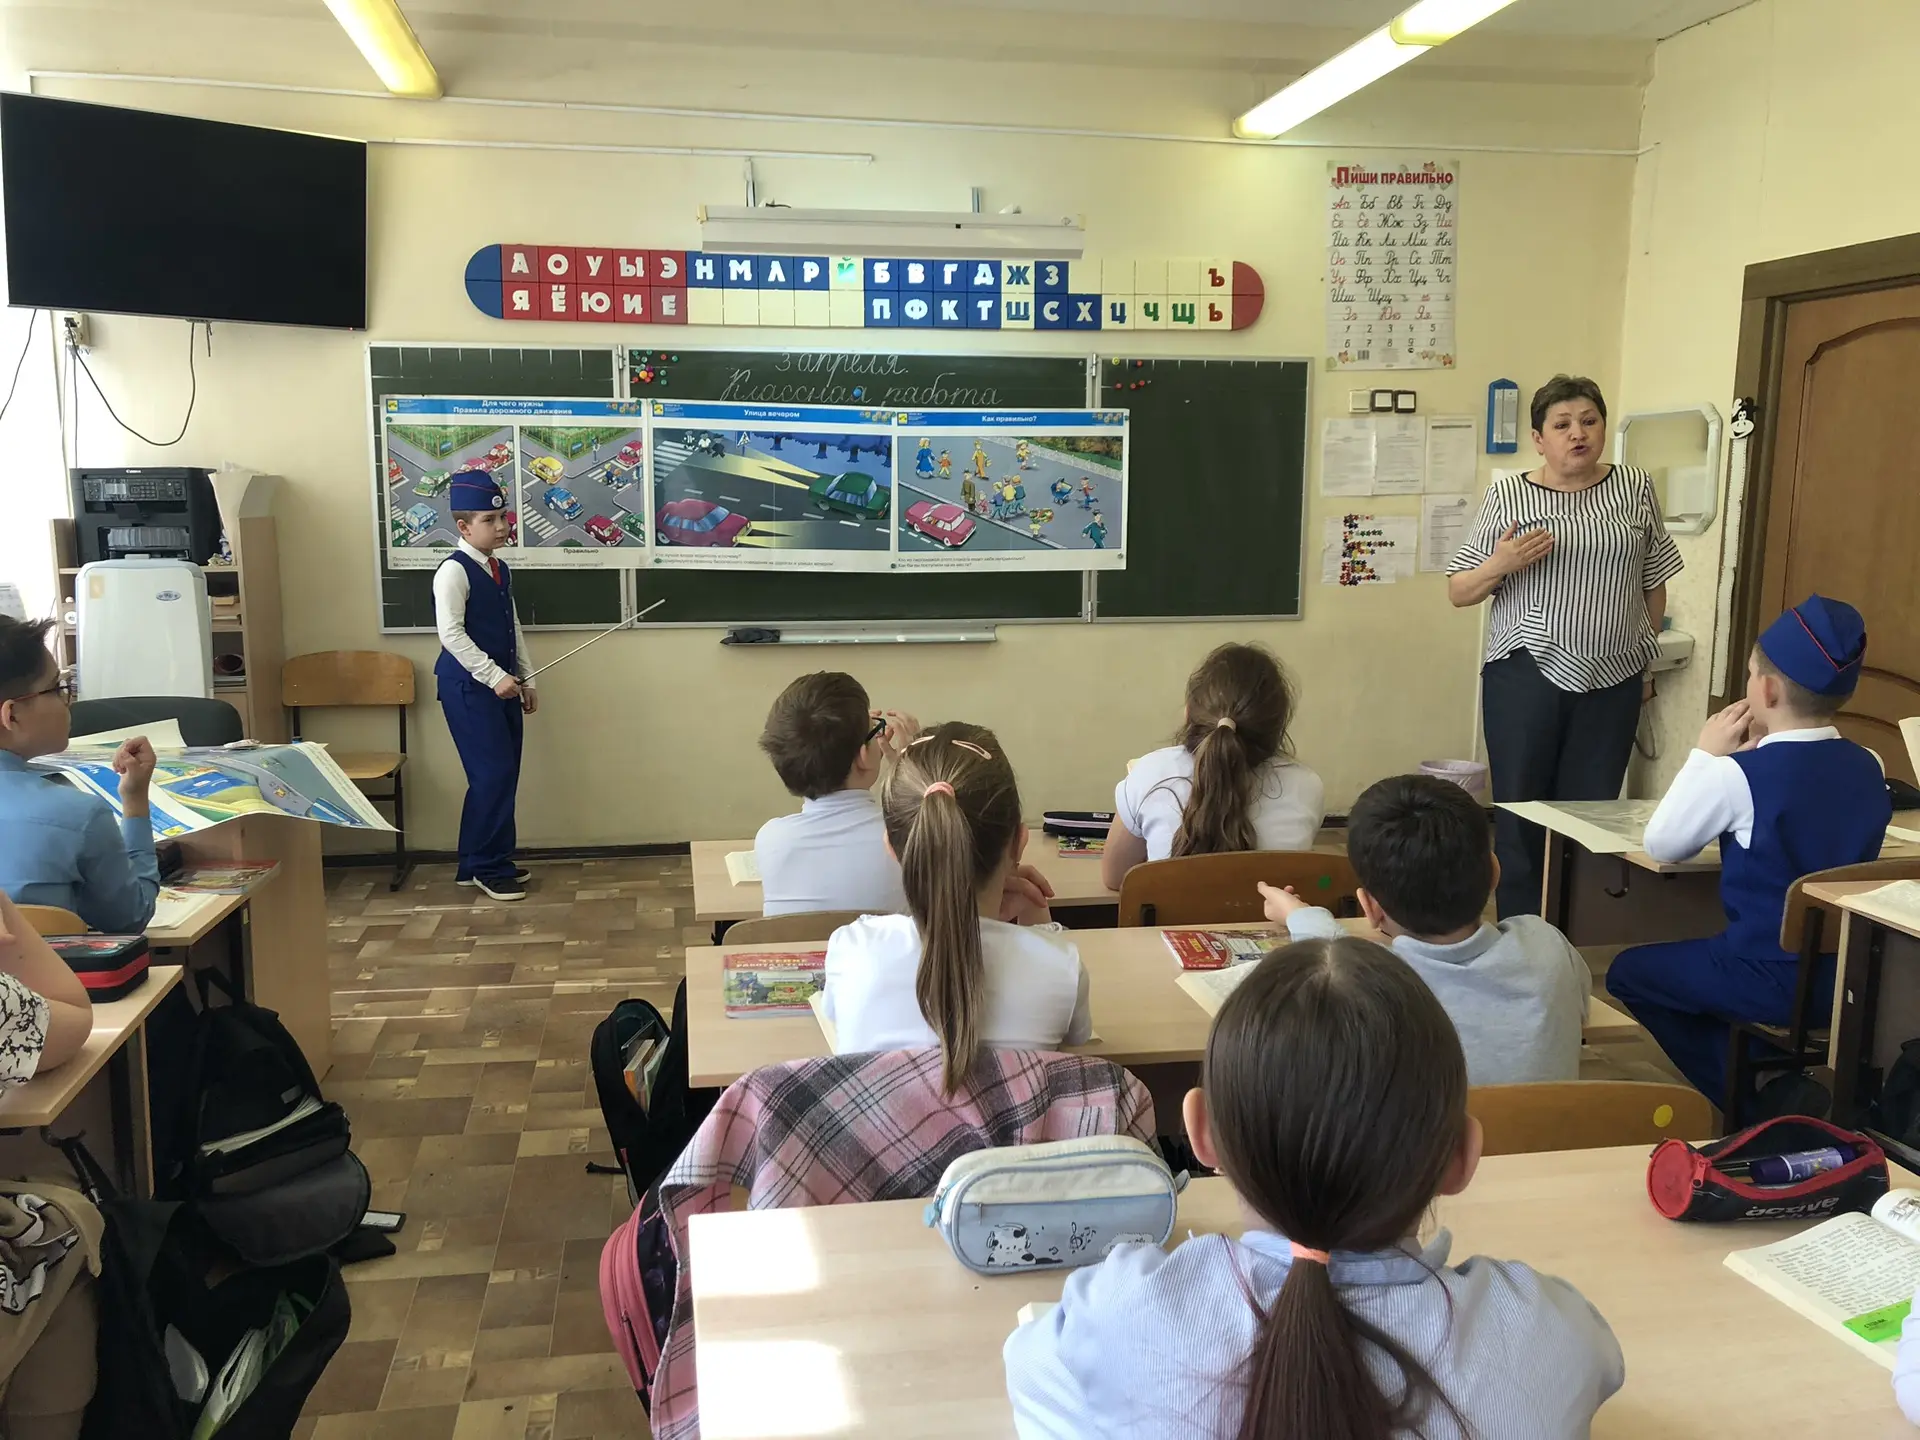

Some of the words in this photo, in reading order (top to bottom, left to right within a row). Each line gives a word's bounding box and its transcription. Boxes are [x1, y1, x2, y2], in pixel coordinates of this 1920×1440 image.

[512, 252, 529, 274] А
[547, 254, 568, 275] О
[587, 255, 602, 276] У
[619, 256, 644, 277] Ы
[660, 255, 677, 277] Э
[695, 258, 714, 281] Н
[728, 259, 752, 282] М
[768, 260, 786, 282] Л
[803, 262, 820, 282] Р
[874, 263, 890, 284] Б
[908, 264, 925, 284] В
[943, 264, 958, 285] Г
[973, 264, 995, 285] Д
[1006, 265, 1031, 285] Ж
[1044, 266, 1059, 285] З
[1208, 268, 1225, 287] Ъ
[513, 290, 530, 311] Я
[552, 285, 567, 312] Ё
[581, 290, 610, 313] Ю
[623, 293, 643, 314] И
[662, 295, 676, 316] Е
[872, 298, 891, 319] П
[904, 298, 928, 319] Ф
[942, 300, 958, 321] К
[977, 300, 993, 320] Т
[1006, 301, 1030, 321] Ш
[1043, 300, 1059, 321] С
[1076, 302, 1093, 322] Х
[1111, 302, 1127, 324] Ц
[1144, 302, 1159, 321] Ч
[1172, 302, 1195, 324] Щ
[1208, 303, 1223, 321] Ь
[881, 372, 1003, 406] работа
[482, 400, 498, 408] Для
[488, 408, 532, 416] дорожного
[534, 408, 572, 416] движения
[744, 409, 765, 418] Улица
[767, 410, 800, 418] вечером
[996, 415, 1037, 423] правильно?
